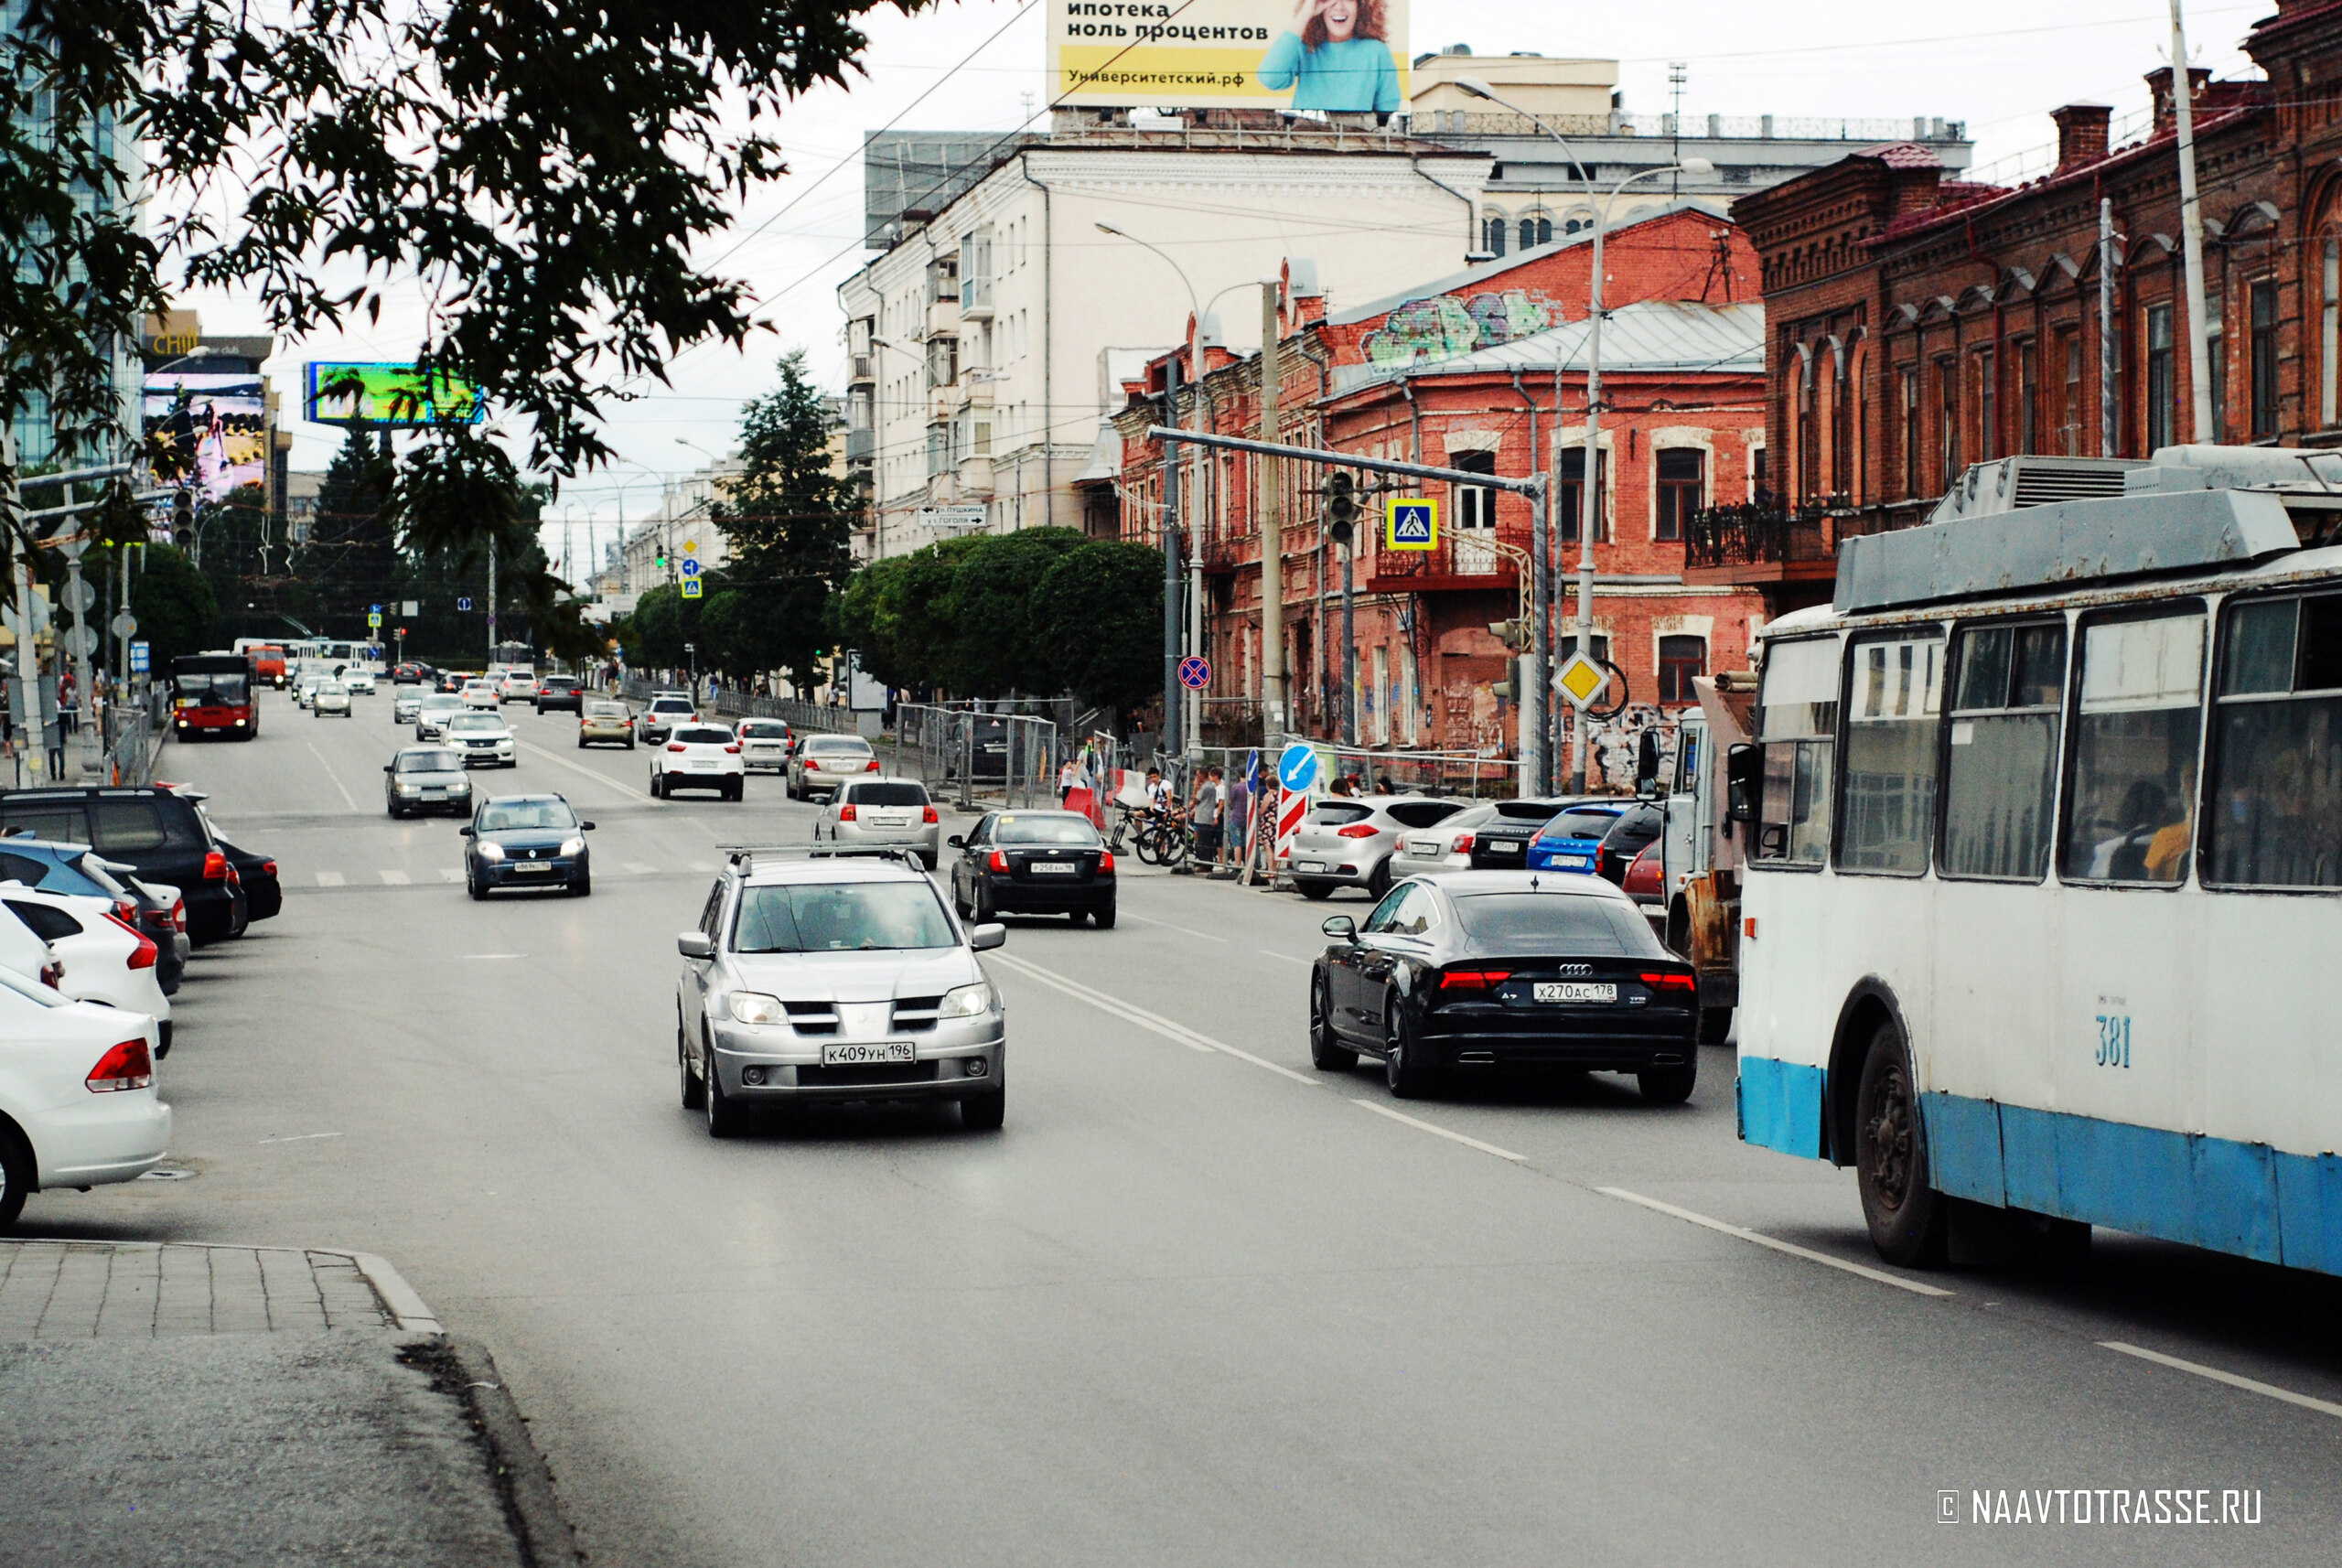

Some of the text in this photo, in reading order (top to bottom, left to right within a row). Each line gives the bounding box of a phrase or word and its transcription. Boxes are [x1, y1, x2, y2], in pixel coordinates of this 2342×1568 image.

[1068, 3, 1170, 18] ипотека
[1068, 23, 1269, 42] ноль процентов
[1069, 70, 1245, 88] Университетский.рф
[1594, 984, 1614, 995] 178
[2096, 1015, 2131, 1069] 381
[888, 1045, 910, 1056] 196
